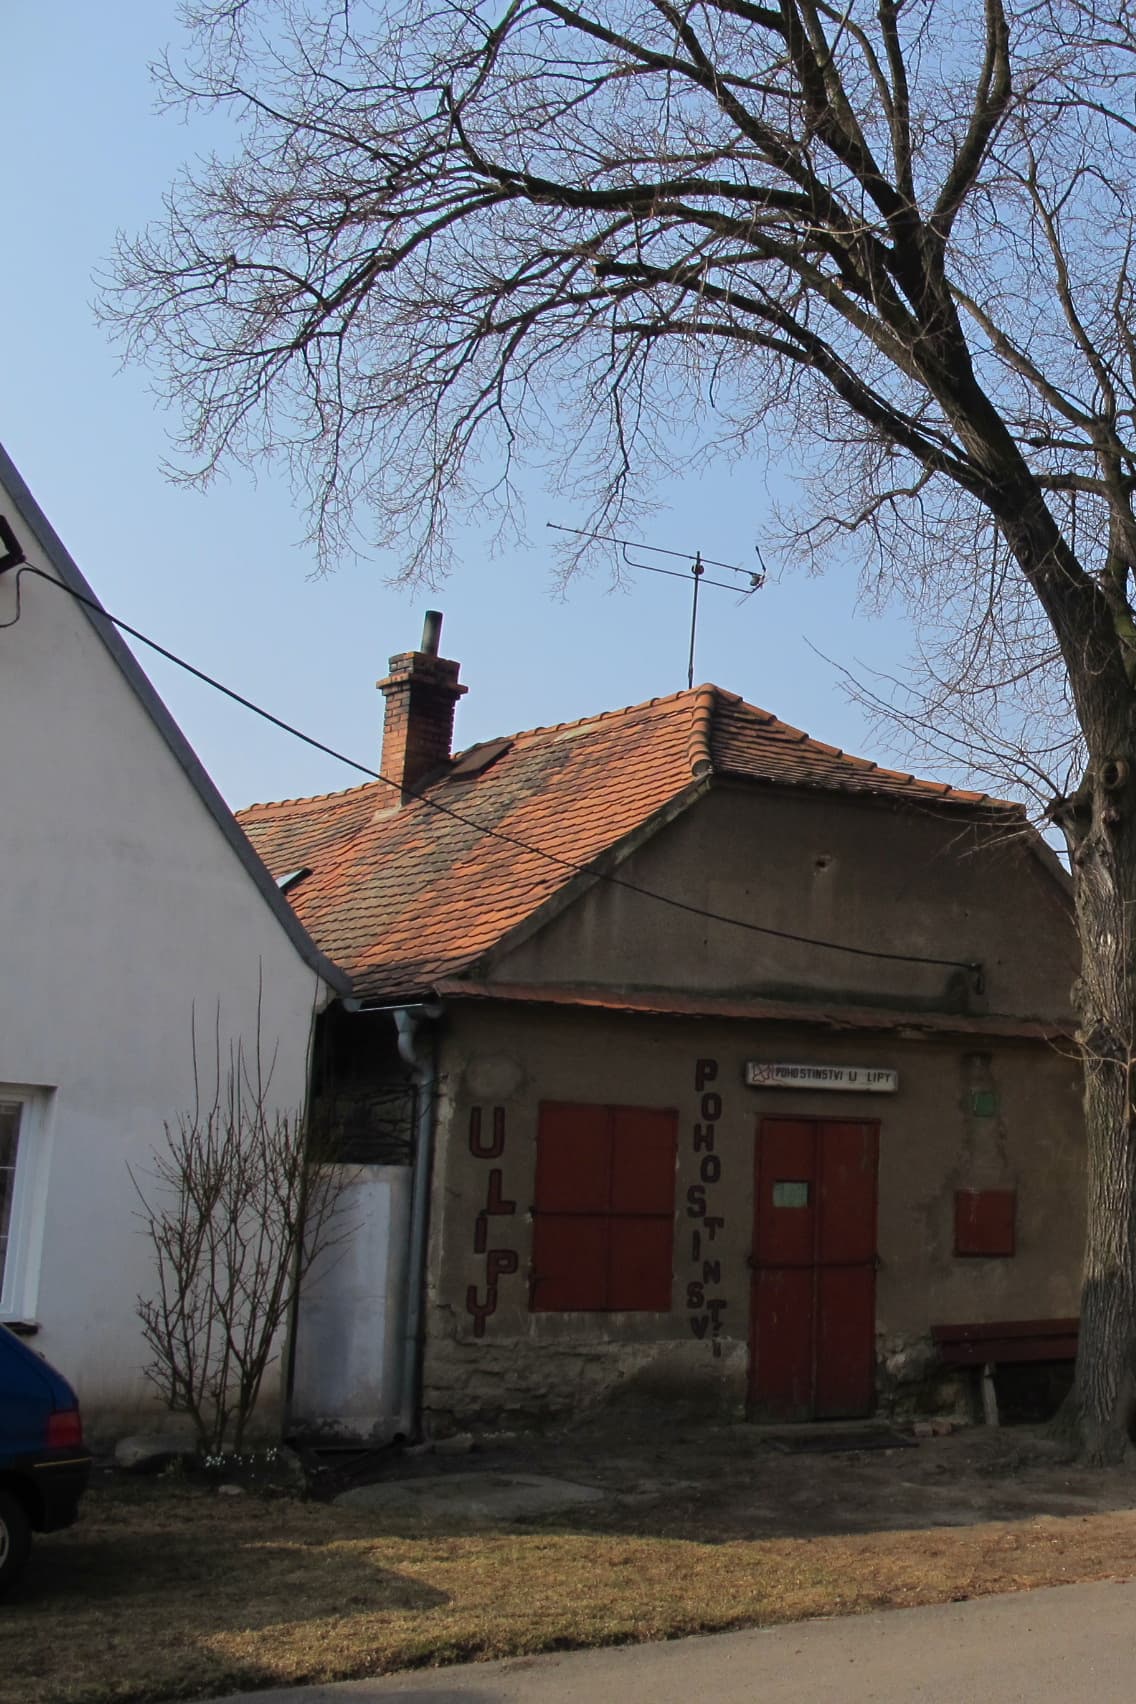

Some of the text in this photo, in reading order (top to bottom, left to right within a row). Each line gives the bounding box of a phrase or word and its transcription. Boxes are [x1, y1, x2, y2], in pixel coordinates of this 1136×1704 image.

[848, 1071, 858, 1082] U
[867, 1071, 891, 1083] LIPY
[466, 1106, 519, 1338] U LIPY
